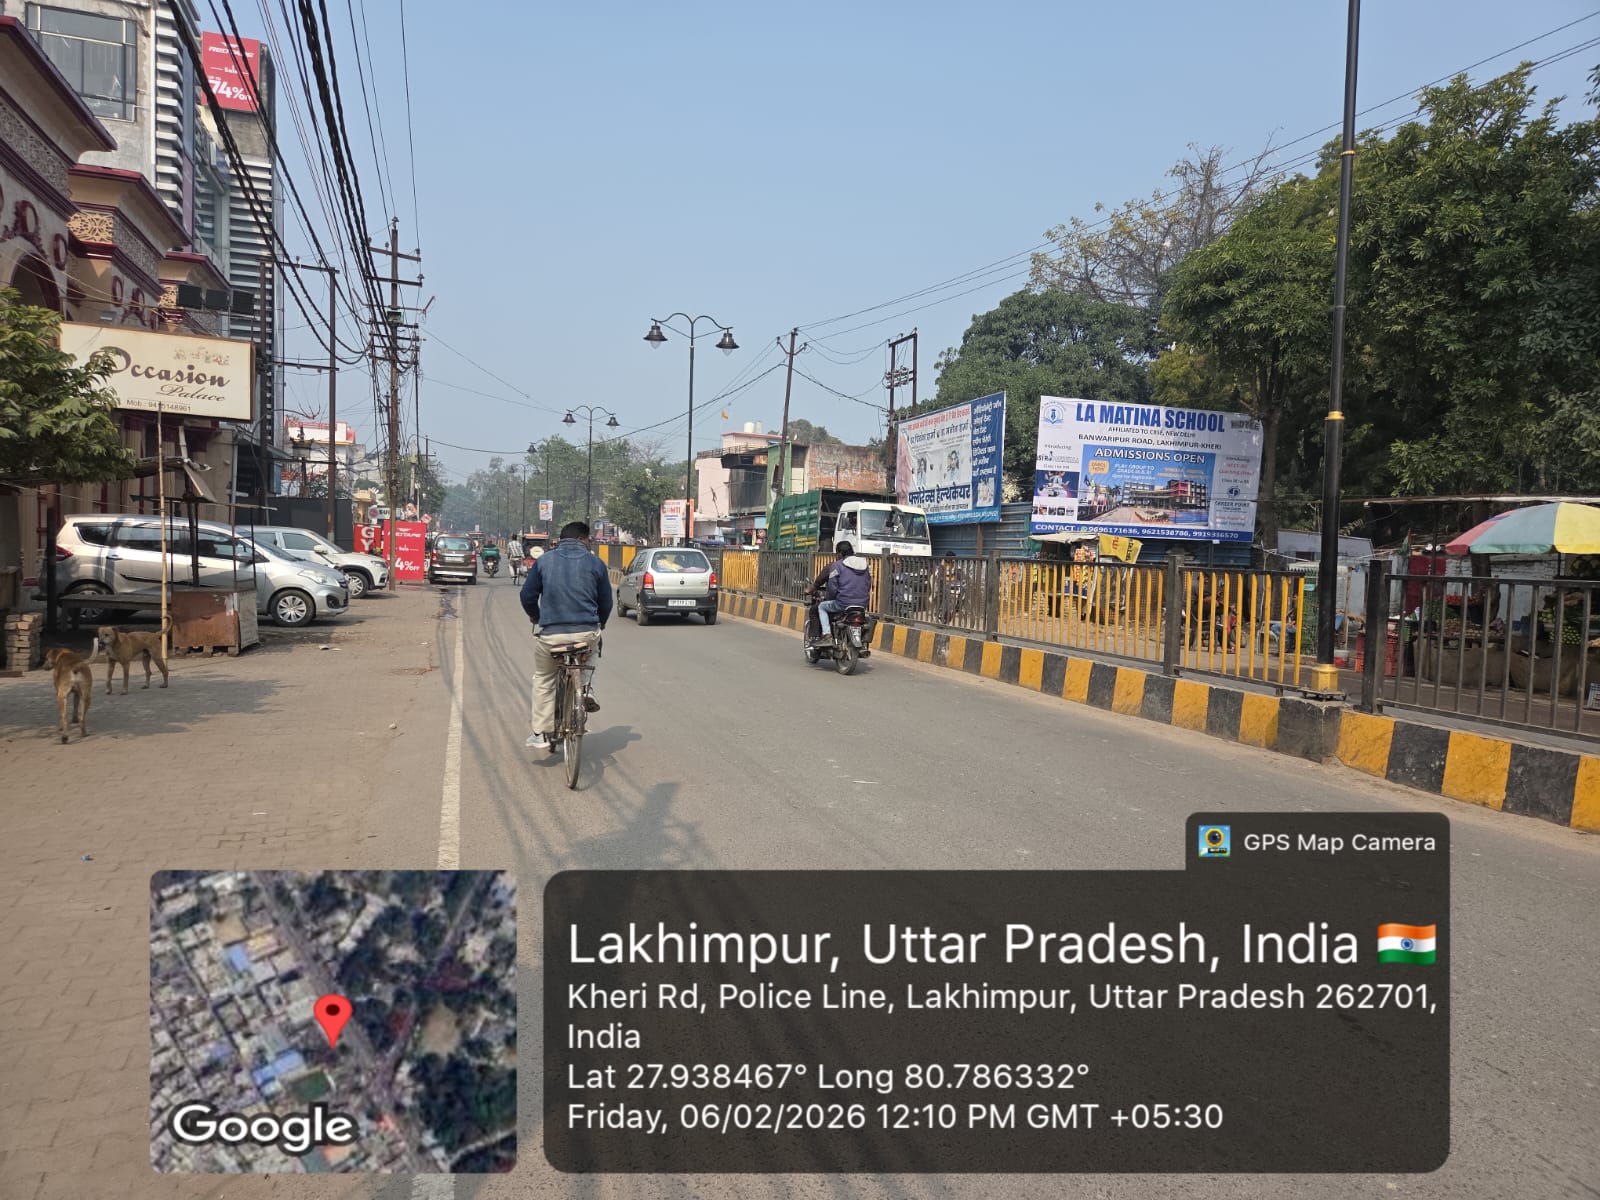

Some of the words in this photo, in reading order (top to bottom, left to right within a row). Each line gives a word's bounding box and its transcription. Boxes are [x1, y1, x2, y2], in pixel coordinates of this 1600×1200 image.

[90, 346, 230, 387] Occasion
[156, 384, 225, 402] Palace
[1076, 403, 1095, 422] LA
[1099, 405, 1161, 428] MATINA
[1165, 409, 1224, 432] SCHOOL
[1078, 433, 1130, 444] BANWARIPUR
[1132, 437, 1155, 446] ROAD,
[1095, 447, 1170, 461] ADMISSIONS
[1173, 453, 1205, 464] OPEN
[1035, 524, 1075, 532] CONTACT
